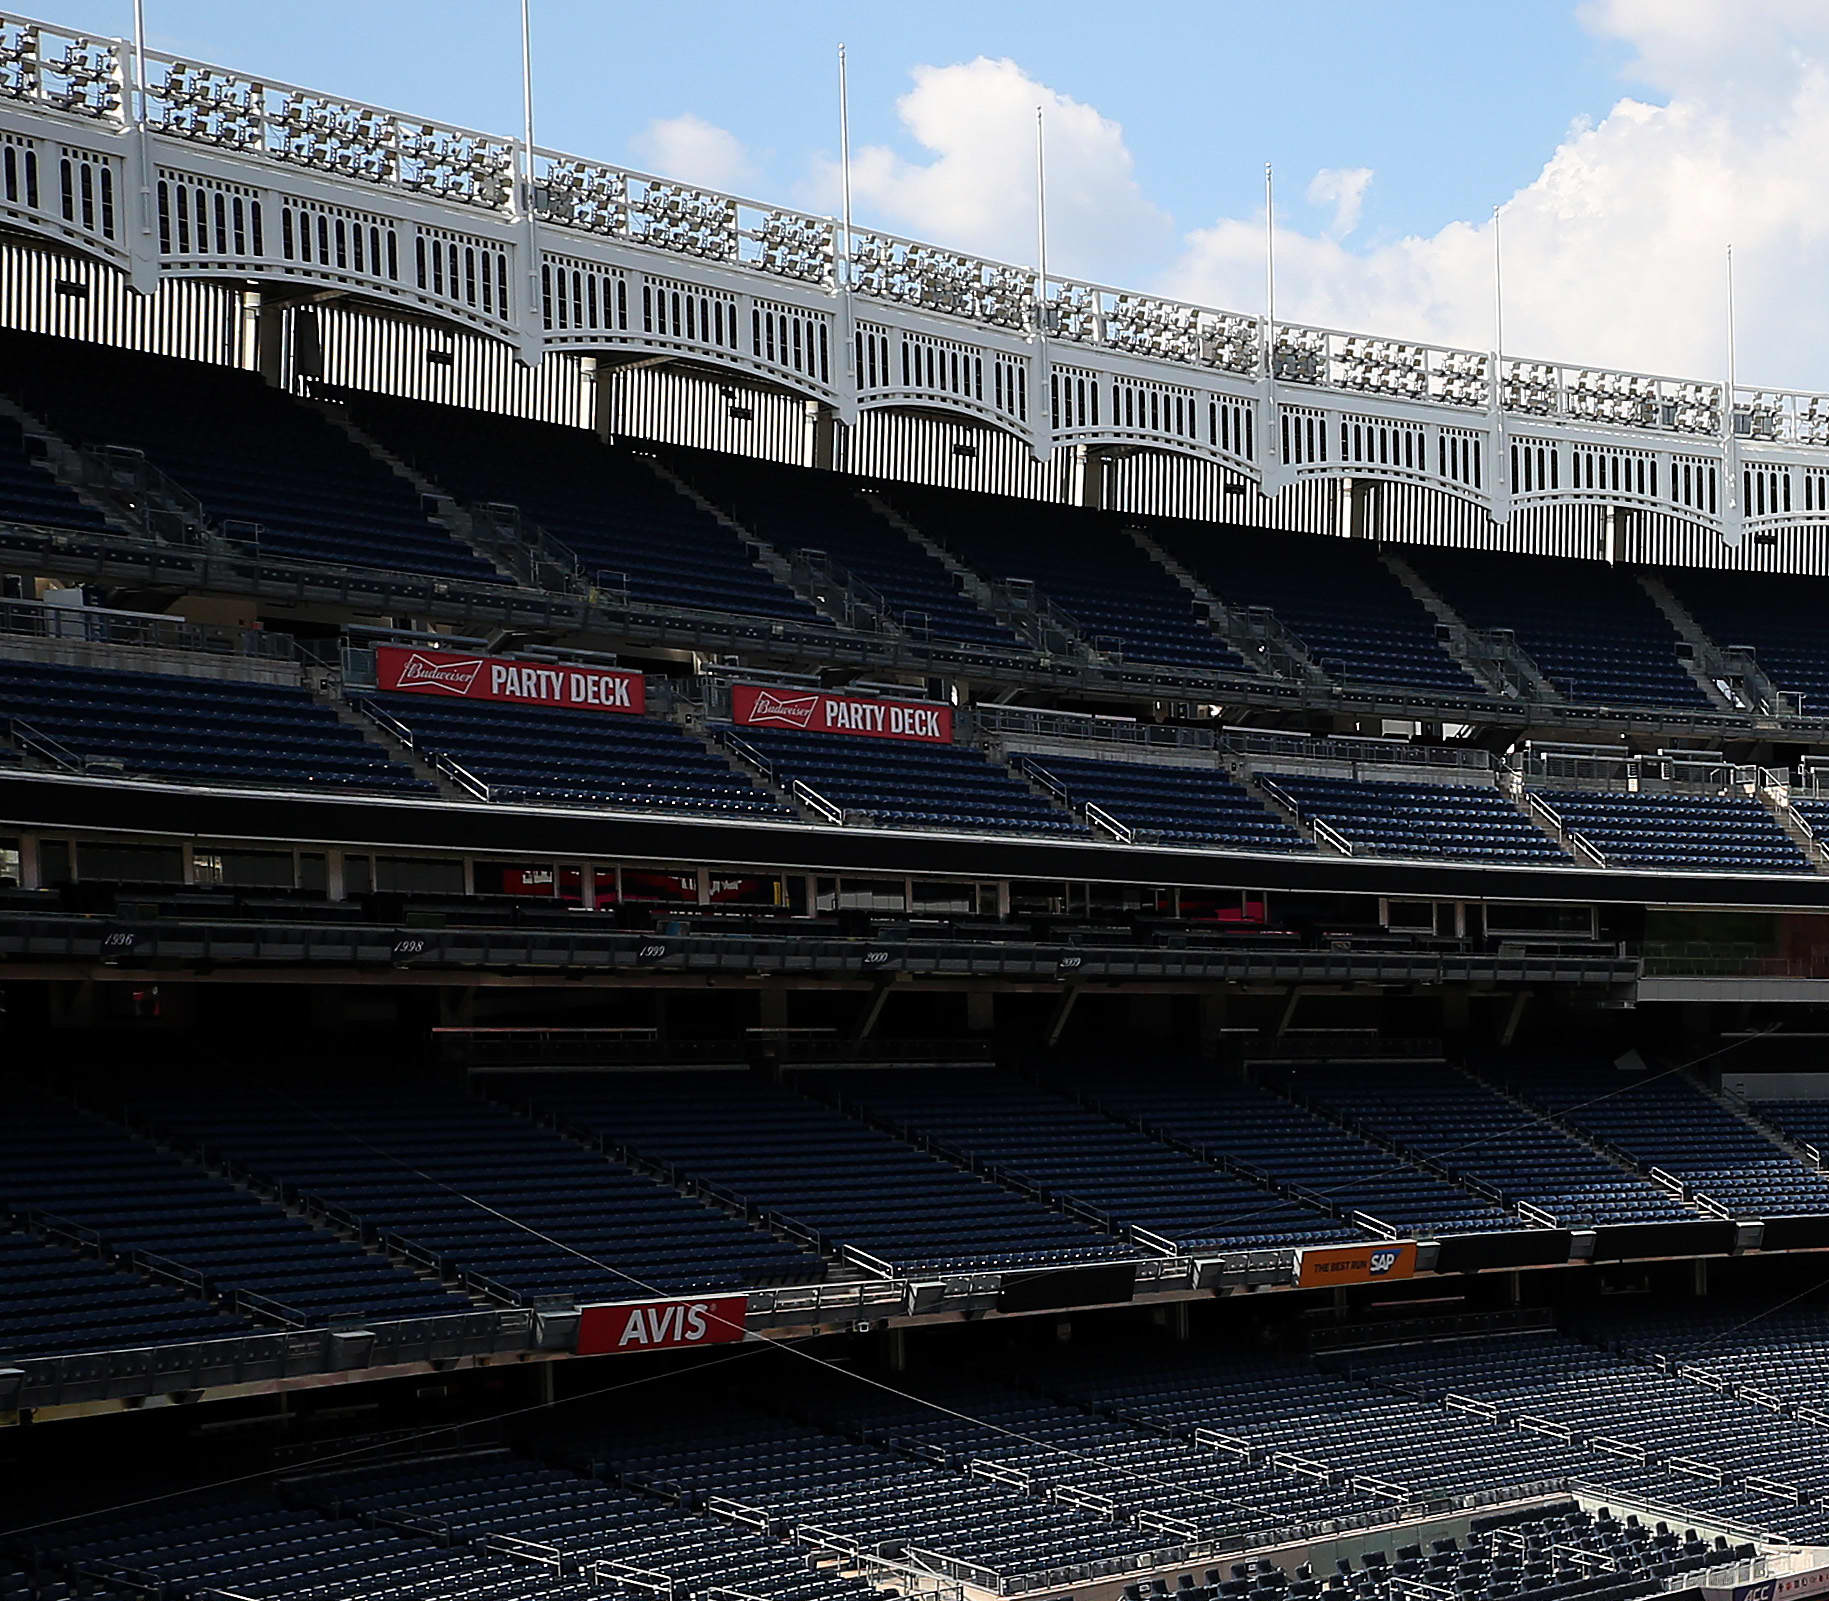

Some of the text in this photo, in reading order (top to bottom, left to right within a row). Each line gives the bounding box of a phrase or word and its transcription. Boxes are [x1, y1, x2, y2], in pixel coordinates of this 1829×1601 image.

[403, 660, 632, 707] Budweiser PARTY DECK
[758, 698, 941, 738] Budweiser PARTY DECK
[393, 940, 425, 952] 1998
[639, 945, 666, 957] 1999
[1314, 1263, 1329, 1273] THE
[1330, 1261, 1350, 1272] BEST
[1369, 1253, 1397, 1272] SAP
[618, 1303, 709, 1346] AVIS
